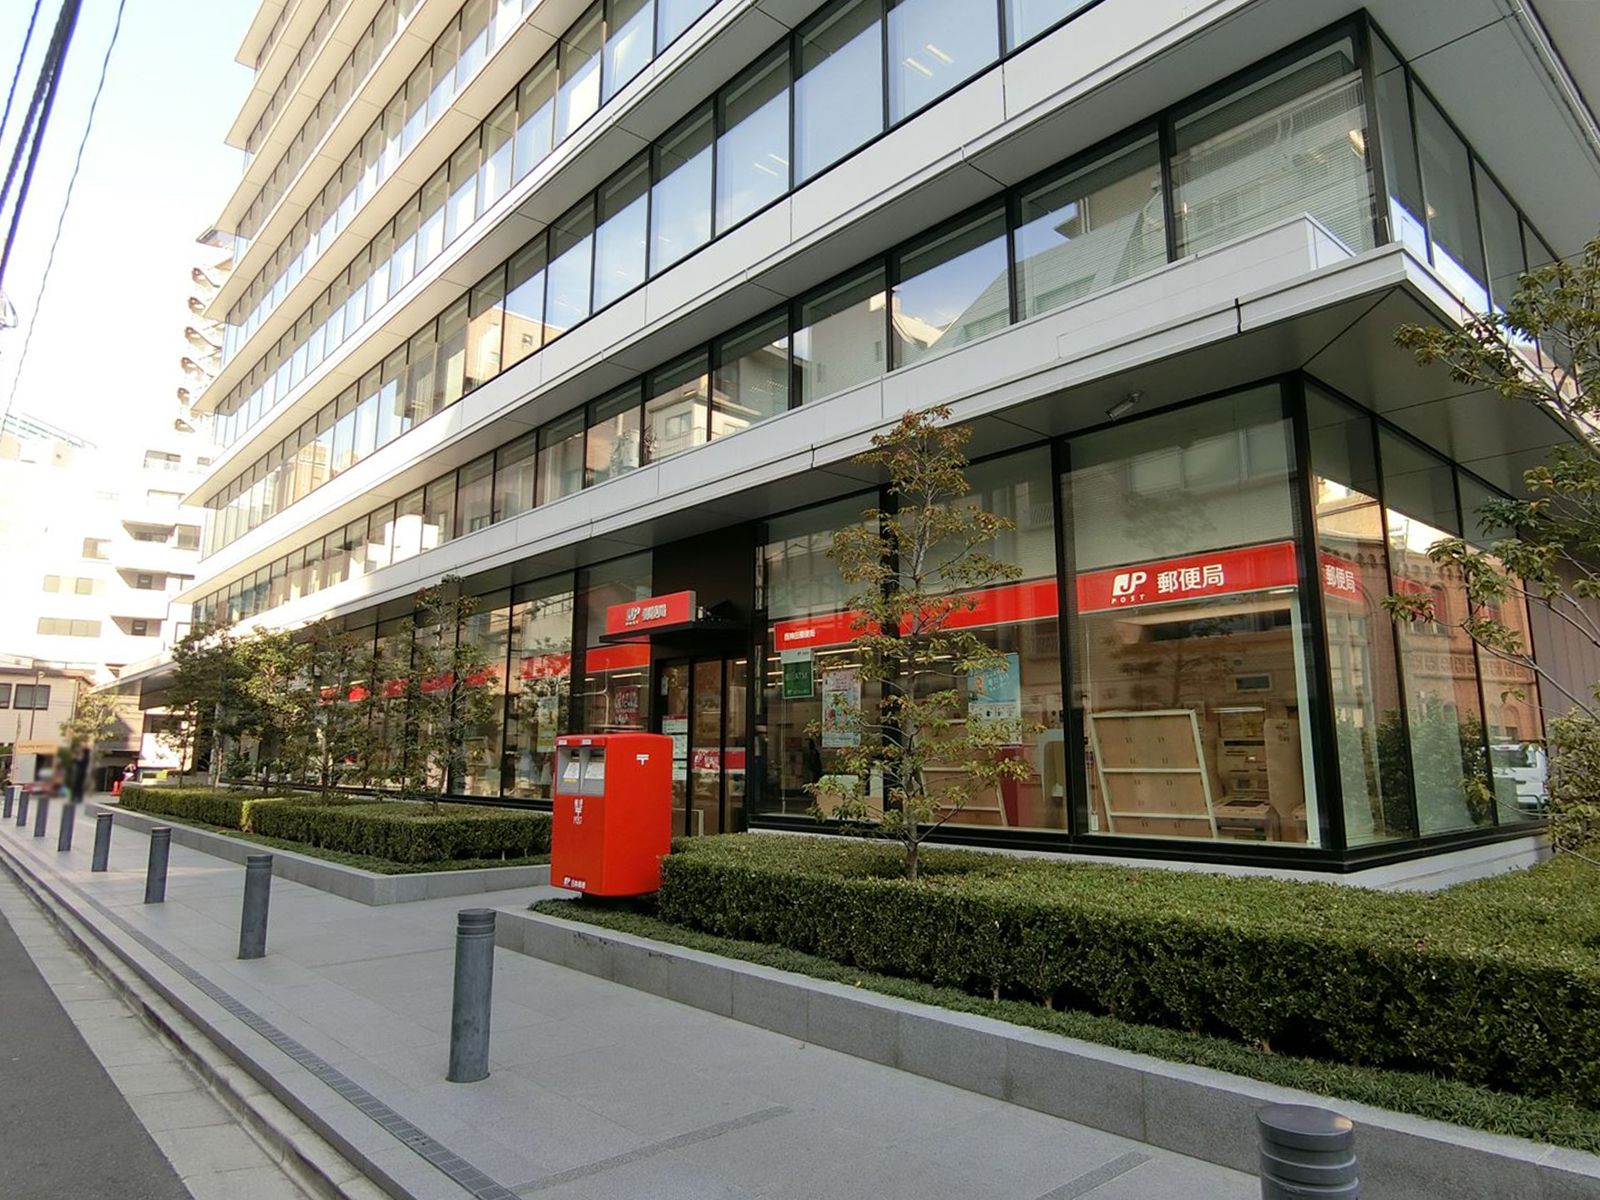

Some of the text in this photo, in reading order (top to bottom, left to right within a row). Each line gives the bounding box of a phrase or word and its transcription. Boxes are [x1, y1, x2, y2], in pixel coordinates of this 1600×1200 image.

[1157, 564, 1225, 594] 郵便局
[1325, 564, 1355, 594] 郵便局
[1111, 594, 1146, 604] POST
